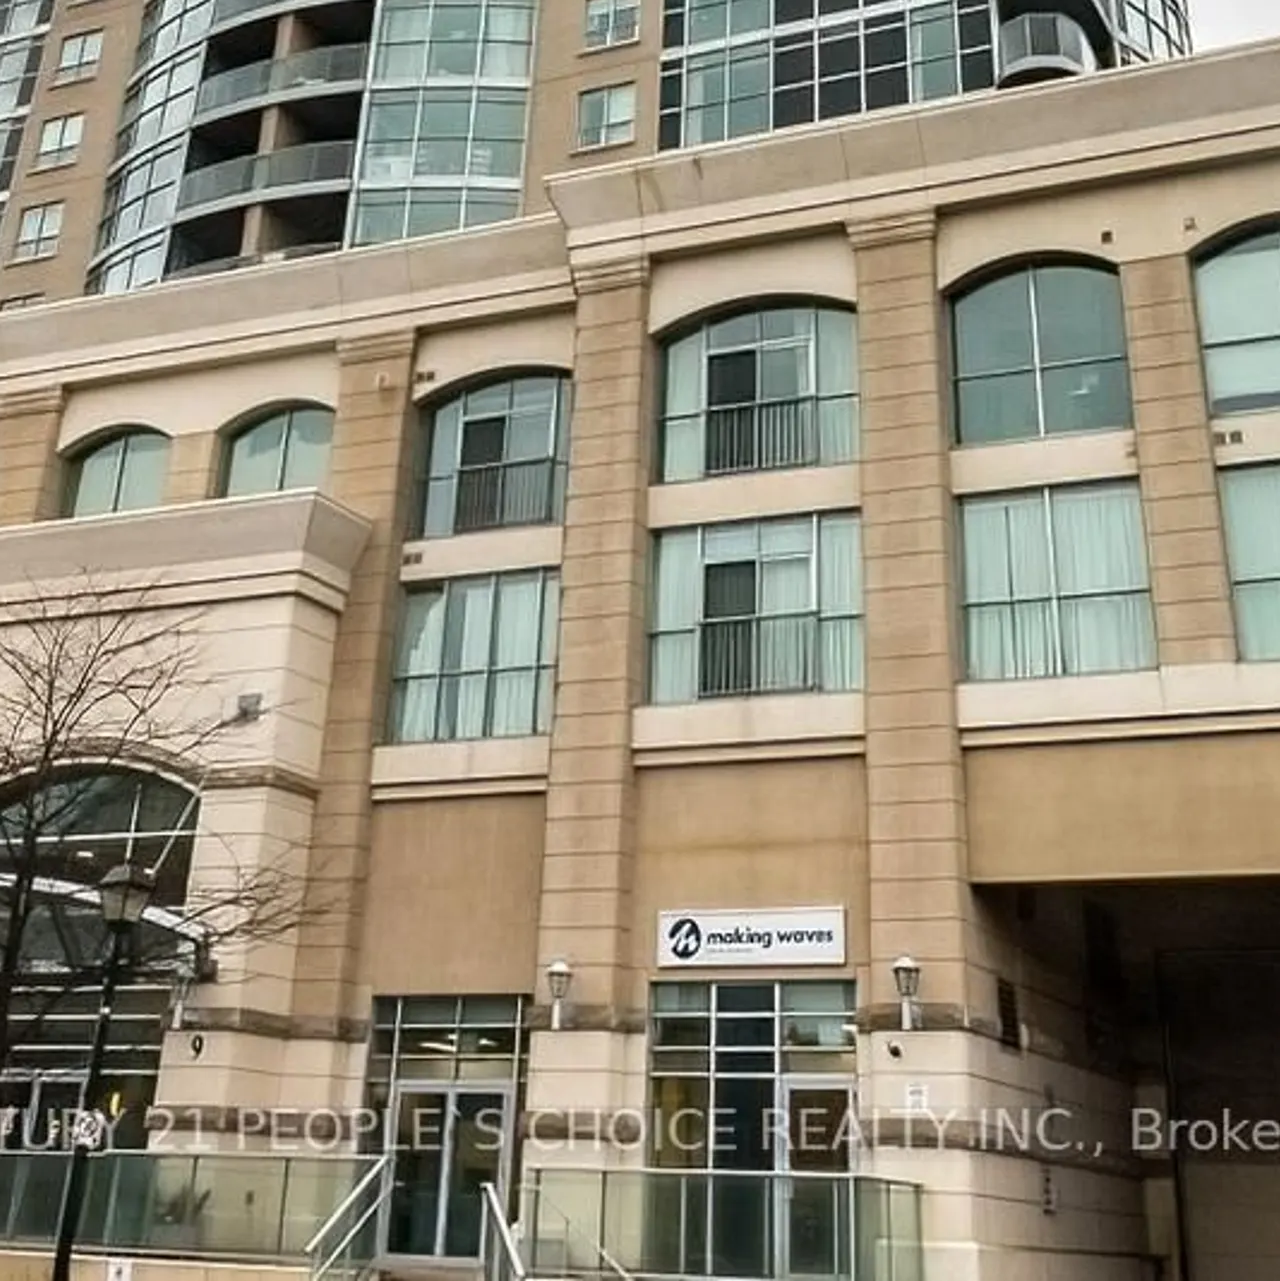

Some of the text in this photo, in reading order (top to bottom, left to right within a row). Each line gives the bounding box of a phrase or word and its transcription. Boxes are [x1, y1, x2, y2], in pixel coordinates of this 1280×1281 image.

[706, 926, 834, 948] making waves
[190, 1034, 204, 1061] 9
